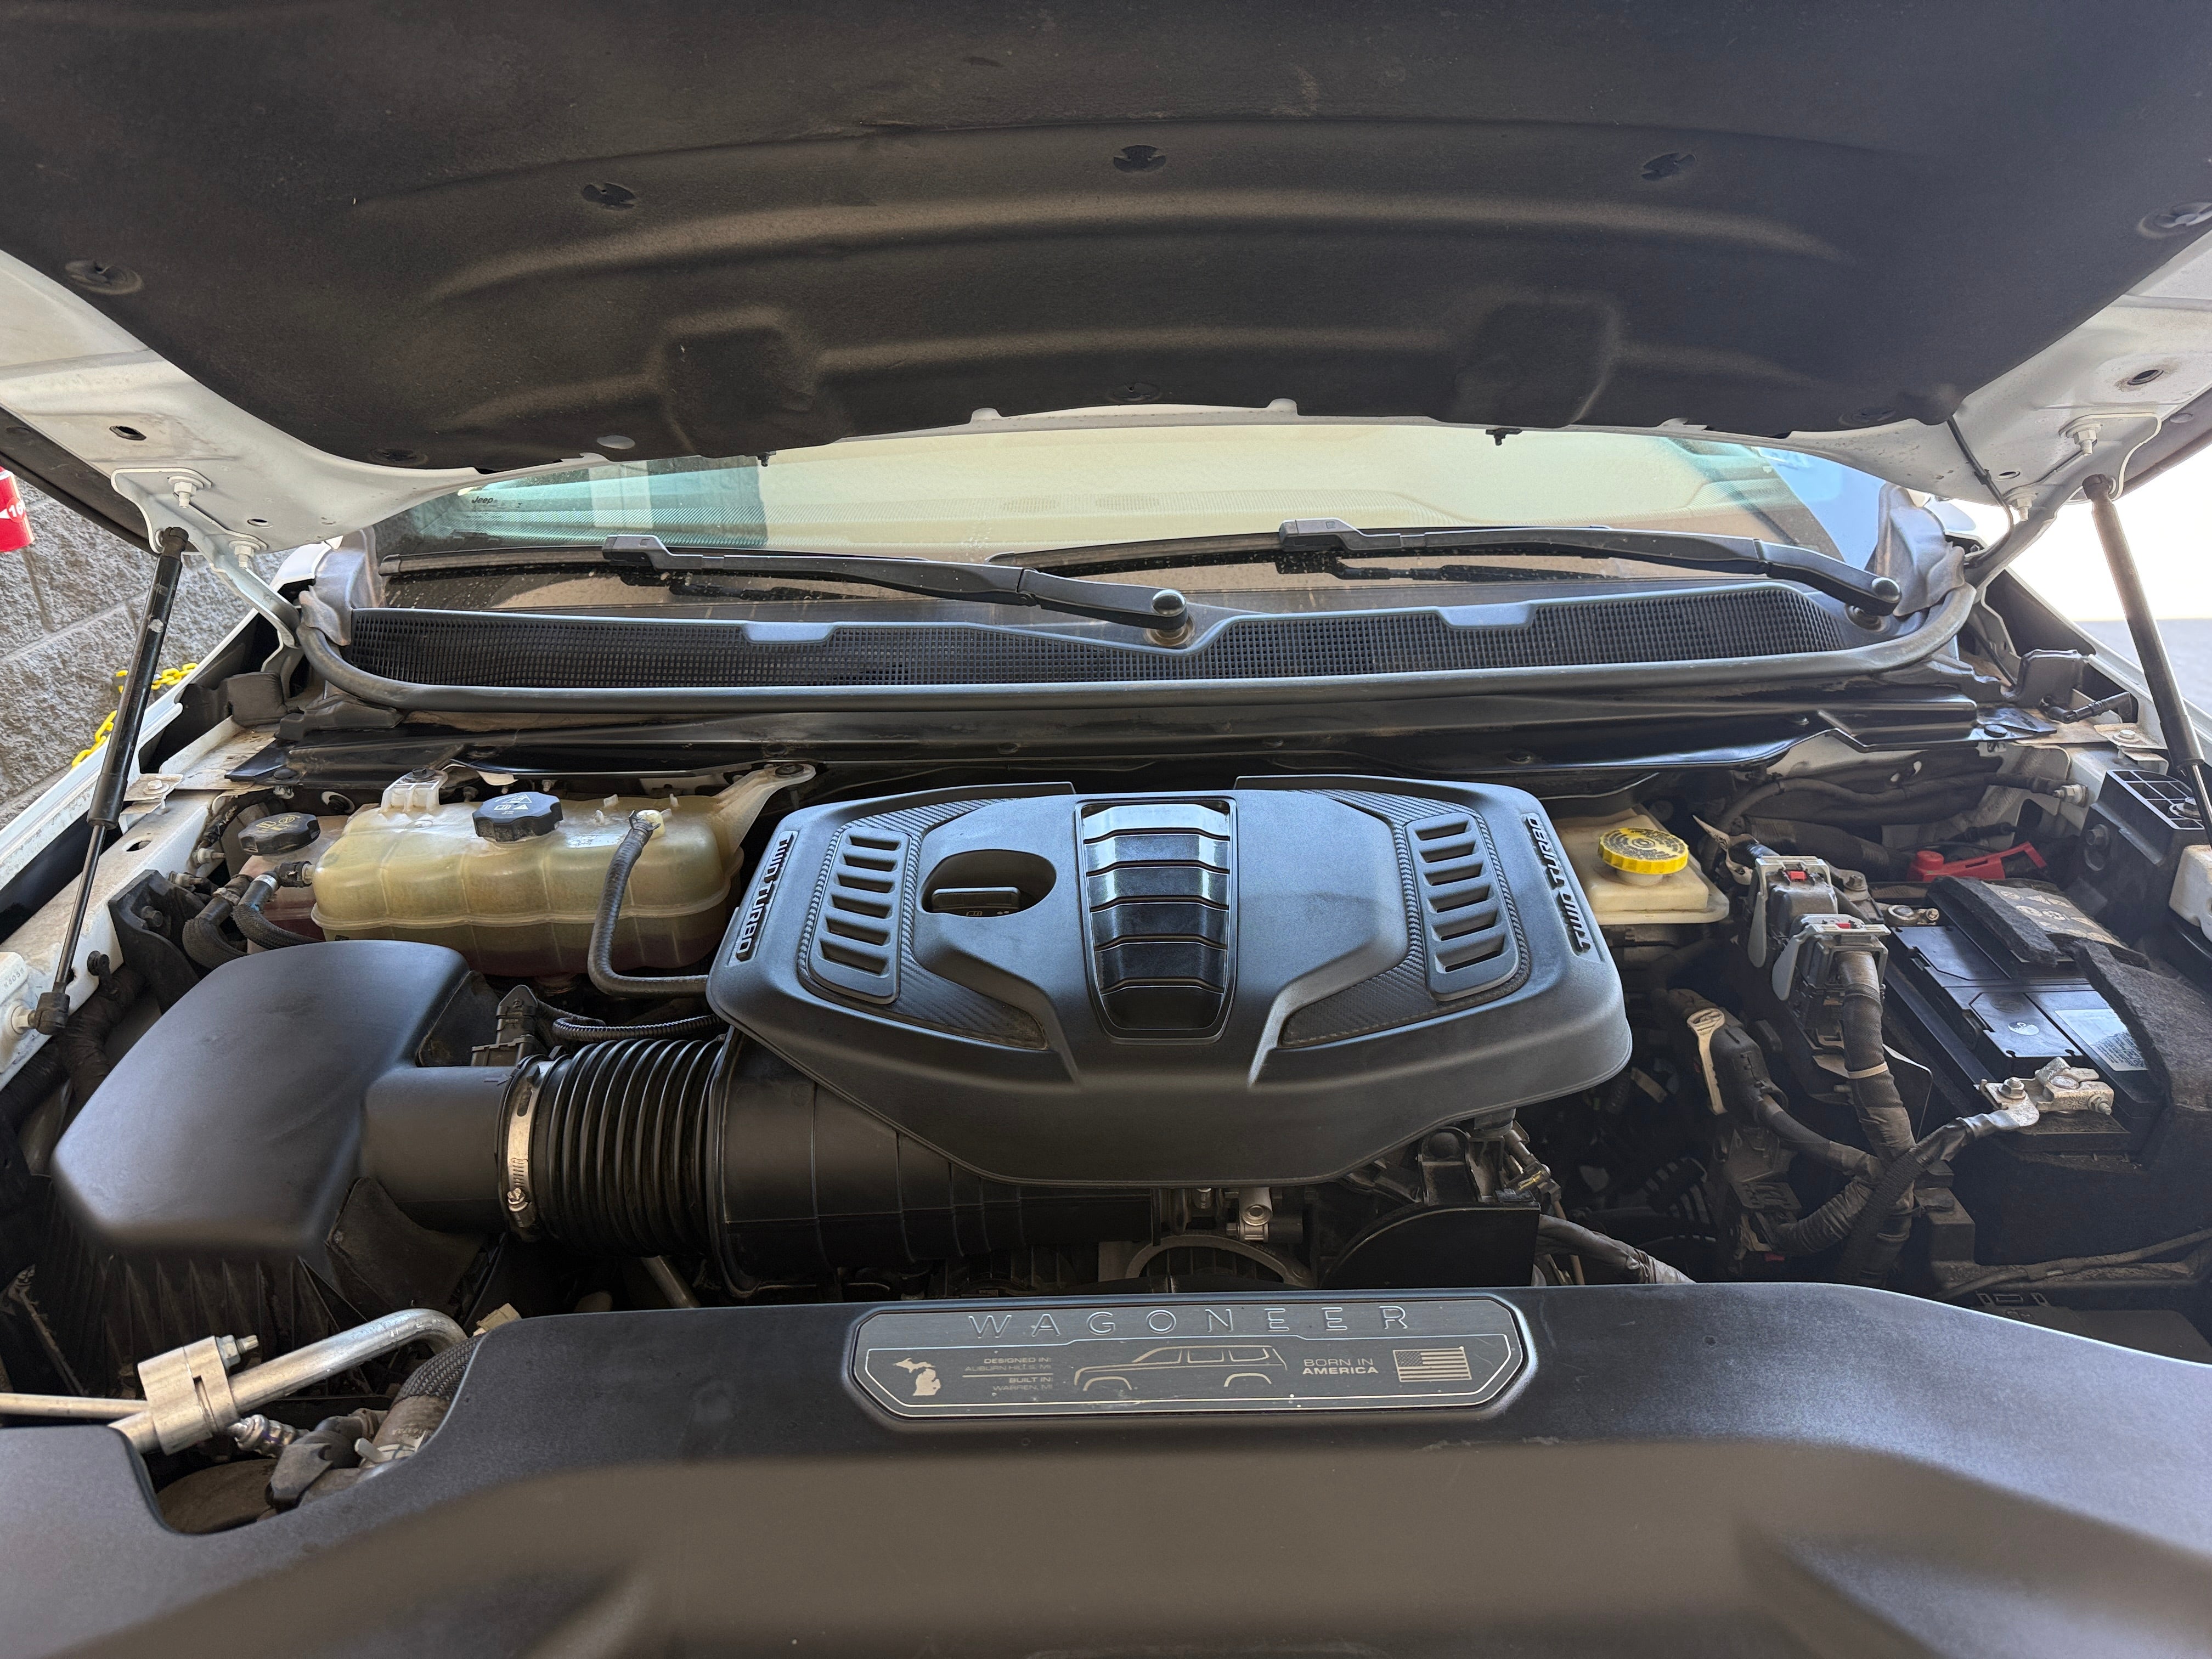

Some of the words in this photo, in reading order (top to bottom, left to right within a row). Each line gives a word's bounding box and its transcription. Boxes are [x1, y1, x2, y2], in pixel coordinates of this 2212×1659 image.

[471, 496, 494, 505] Jeep
[764, 832, 794, 881] TWIN
[1527, 816, 1565, 888] TURBO
[737, 880, 774, 957] TURBO
[1559, 890, 1591, 953] TWIN
[968, 1305, 1408, 1339] WAGONEER
[1302, 1367, 1379, 1375] AMERICA
[1303, 1358, 1351, 1367] BORN
